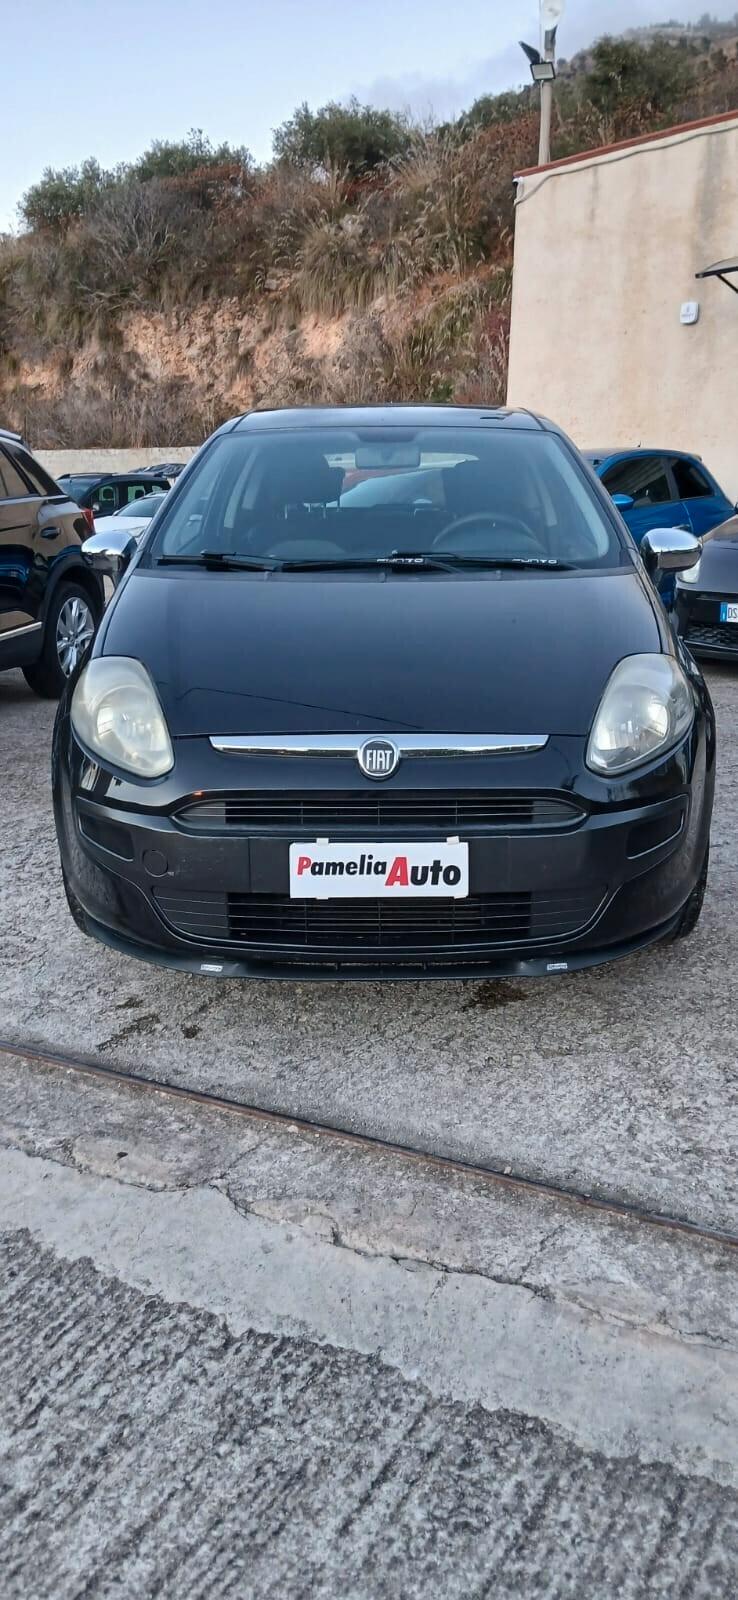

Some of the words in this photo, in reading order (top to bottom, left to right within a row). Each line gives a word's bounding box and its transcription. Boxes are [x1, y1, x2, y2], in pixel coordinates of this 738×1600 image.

[366, 749, 393, 770] FIAT
[297, 854, 387, 876] Pamelia
[385, 856, 462, 886] Auto
